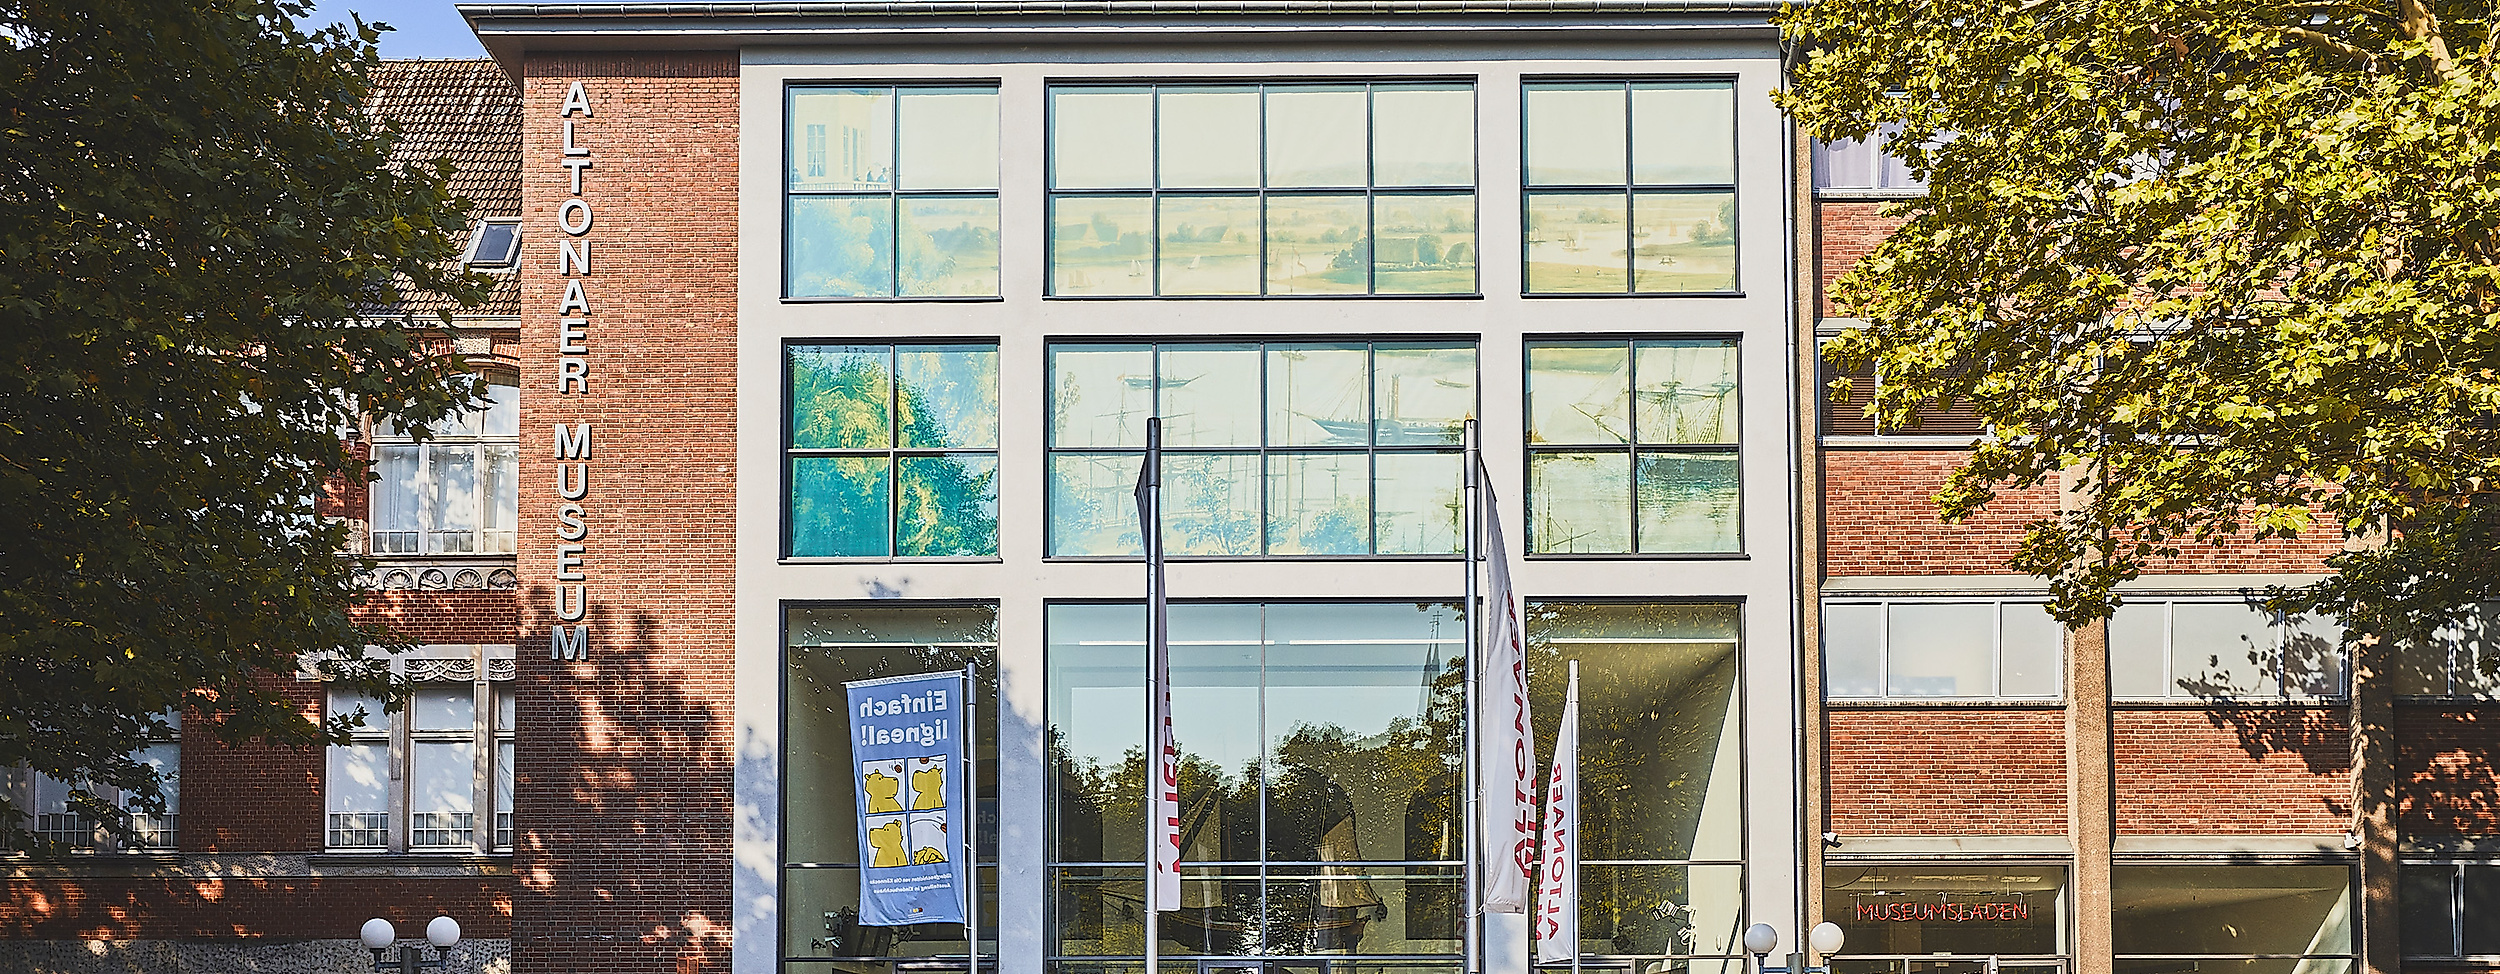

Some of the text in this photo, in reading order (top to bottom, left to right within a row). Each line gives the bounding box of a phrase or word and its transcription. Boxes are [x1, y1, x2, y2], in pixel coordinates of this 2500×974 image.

[551, 81, 593, 662] ALTONAER MUSEUM
[1857, 902, 2028, 921] MUSEUMSLADEN
